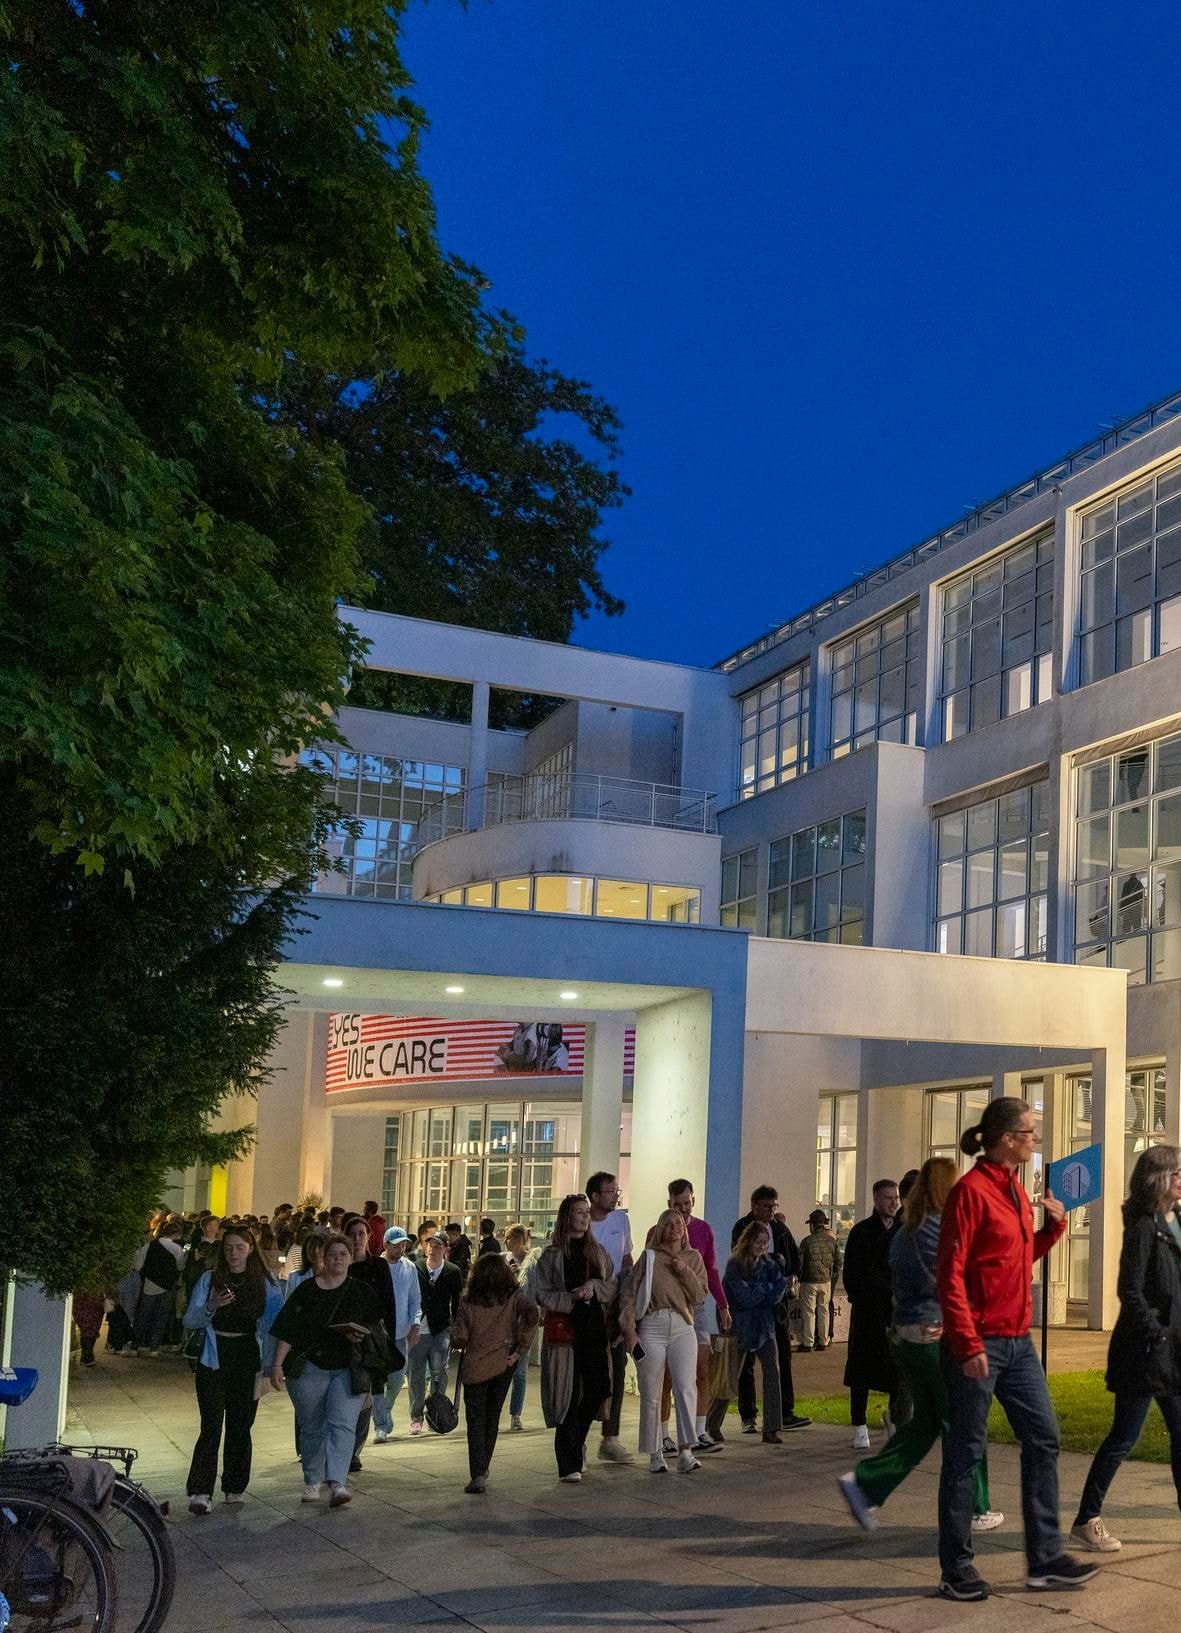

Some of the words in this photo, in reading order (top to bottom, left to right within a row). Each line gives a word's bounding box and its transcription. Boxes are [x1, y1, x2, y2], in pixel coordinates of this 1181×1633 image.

[332, 1014, 361, 1049] YES
[346, 1045, 375, 1081] WE
[379, 1038, 446, 1077] CARE
